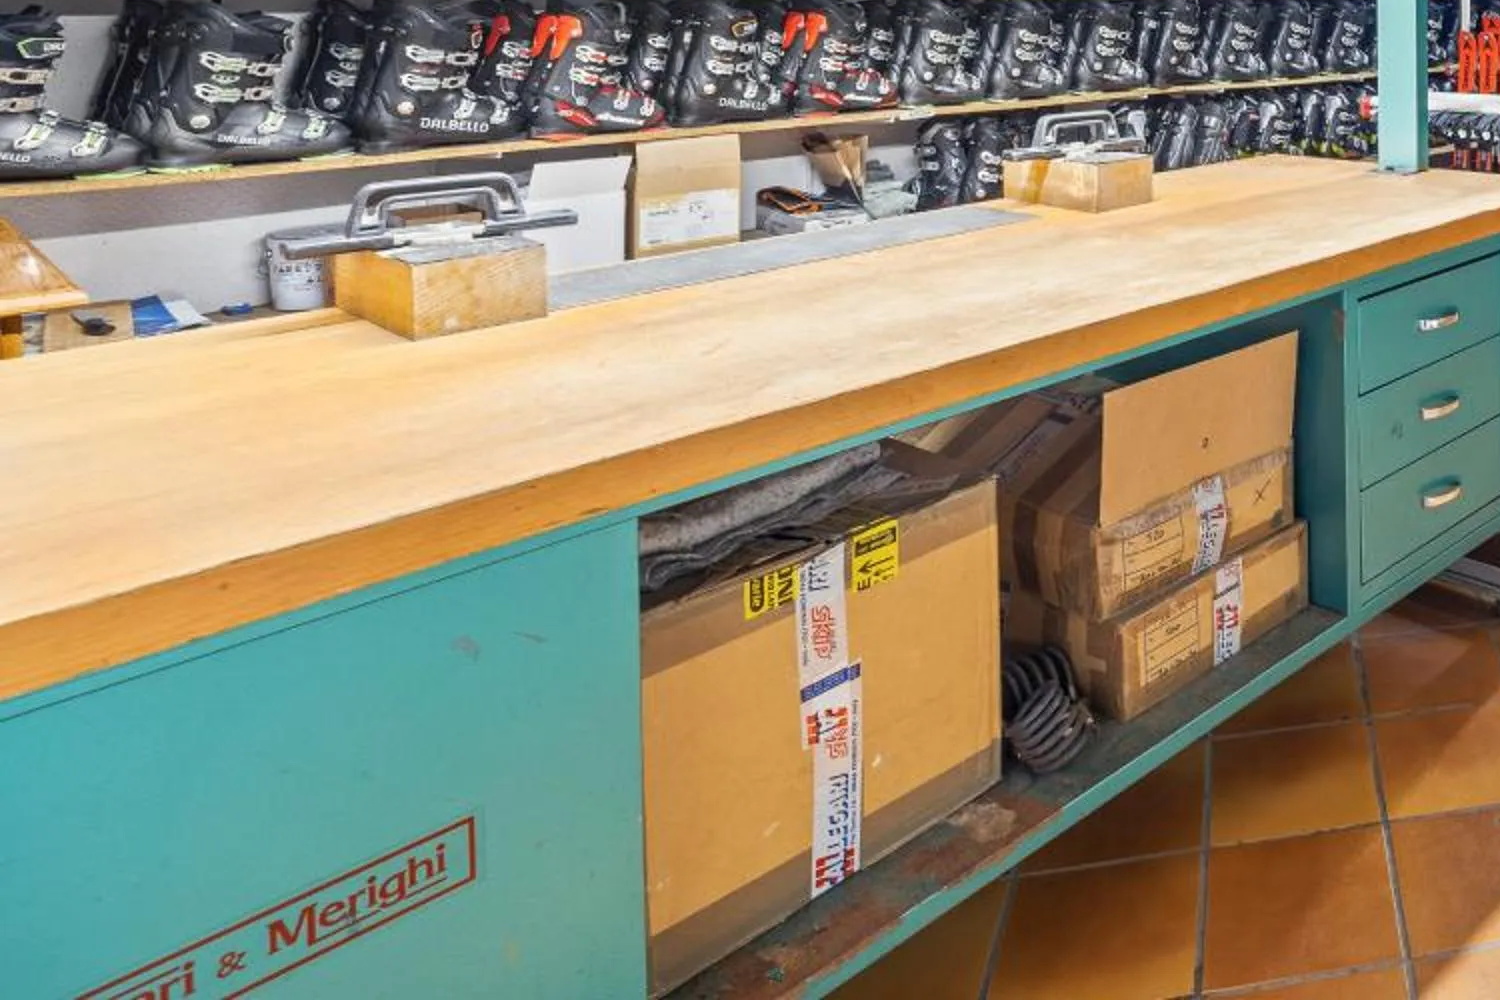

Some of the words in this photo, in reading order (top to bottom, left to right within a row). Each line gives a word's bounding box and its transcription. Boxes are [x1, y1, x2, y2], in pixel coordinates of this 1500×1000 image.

[719, 97, 768, 111] DALBELLO
[419, 116, 490, 133] DALBELLO
[217, 951, 247, 979] &
[266, 843, 447, 956] Merighi
